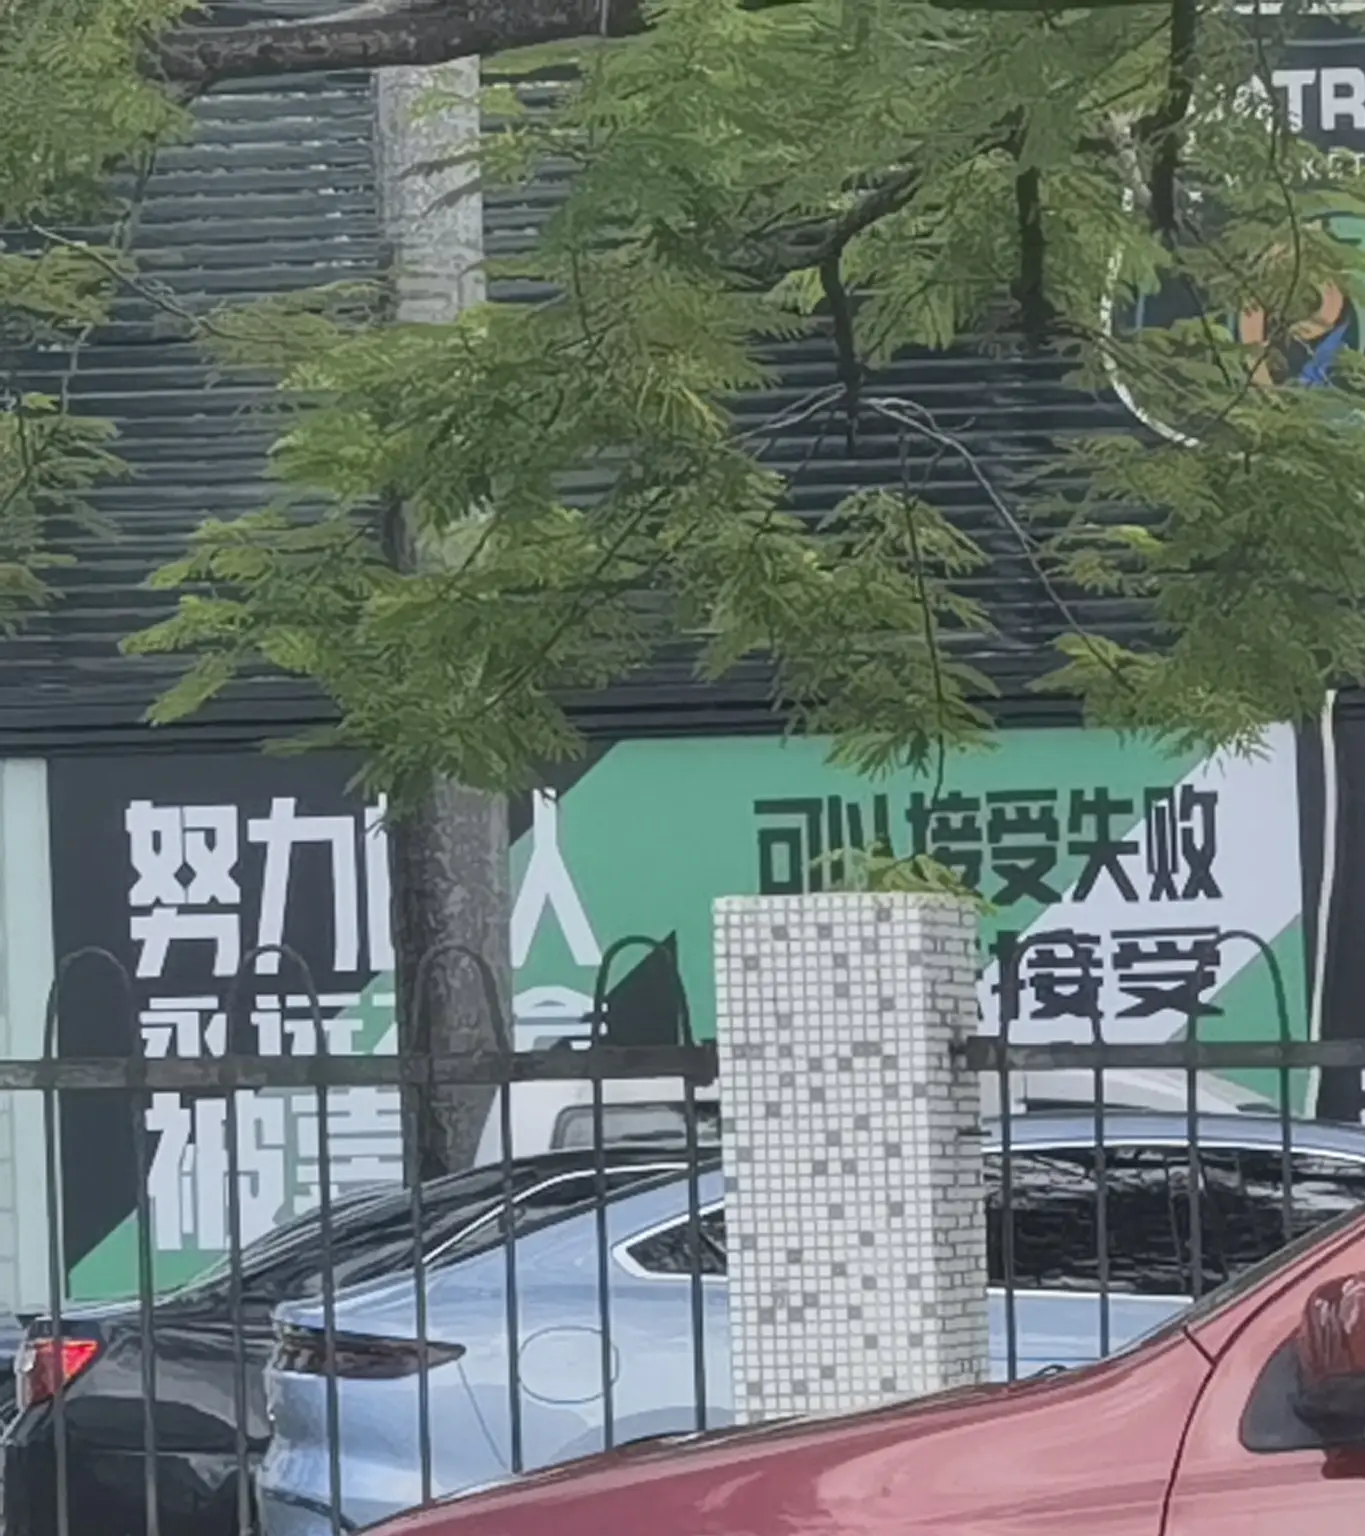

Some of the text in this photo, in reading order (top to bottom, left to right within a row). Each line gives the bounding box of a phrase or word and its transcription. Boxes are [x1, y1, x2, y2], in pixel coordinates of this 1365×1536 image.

[124, 787, 601, 978] 努力人
[754, 784, 1222, 904] 可以接受失败
[976, 925, 1225, 1018] 接受
